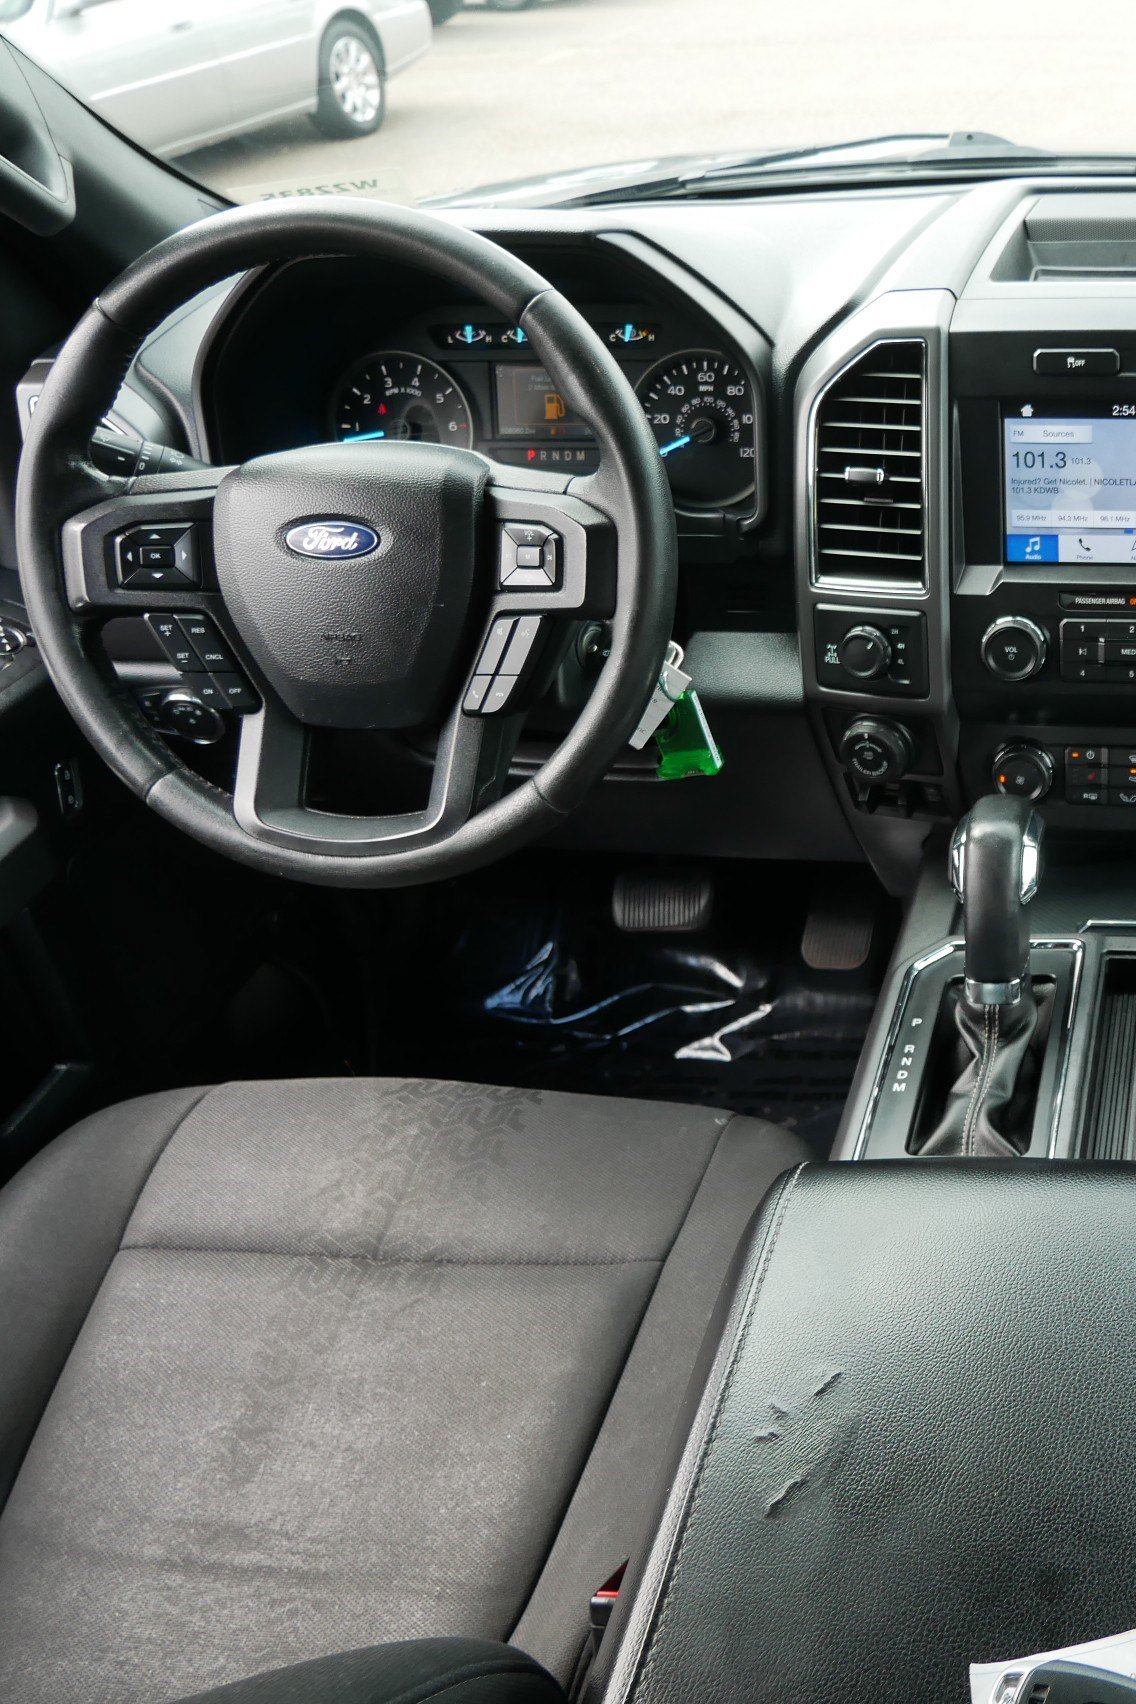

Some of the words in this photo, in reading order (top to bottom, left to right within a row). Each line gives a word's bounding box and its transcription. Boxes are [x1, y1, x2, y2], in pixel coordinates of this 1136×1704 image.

[1075, 359, 1085, 367] OFF
[384, 377, 392, 388] 3
[411, 377, 420, 387] 4
[697, 372, 715, 383] 60
[667, 385, 685, 396] 40
[726, 385, 745, 396] 80
[363, 394, 371, 404] 2
[436, 394, 445, 404] 5
[1112, 405, 1136, 416] 2:54
[653, 414, 670, 425] 20
[742, 414, 754, 424] 10
[449, 421, 458, 432] 6
[1042, 430, 1075, 438] Sources
[527, 448, 537, 461] P
[540, 452, 547, 461] R
[552, 451, 560, 461] N
[564, 451, 572, 461] D
[576, 451, 586, 461] M
[1012, 451, 1067, 469] 101.3
[1070, 457, 1092, 465] 101.3
[1011, 477, 1041, 487] Injured?
[1043, 478, 1057, 486] Get
[1011, 486, 1032, 494] 101.3
[1033, 486, 1059, 494] KDWB
[303, 526, 359, 551] Ford
[1075, 597, 1106, 605] PASSENGER
[1106, 597, 1126, 605] AIRBAG
[824, 656, 841, 664] PULL
[911, 1017, 923, 1027] P
[904, 1044, 915, 1053] R
[901, 1057, 912, 1066] N
[896, 1070, 908, 1079] D
[892, 1082, 906, 1092] M
